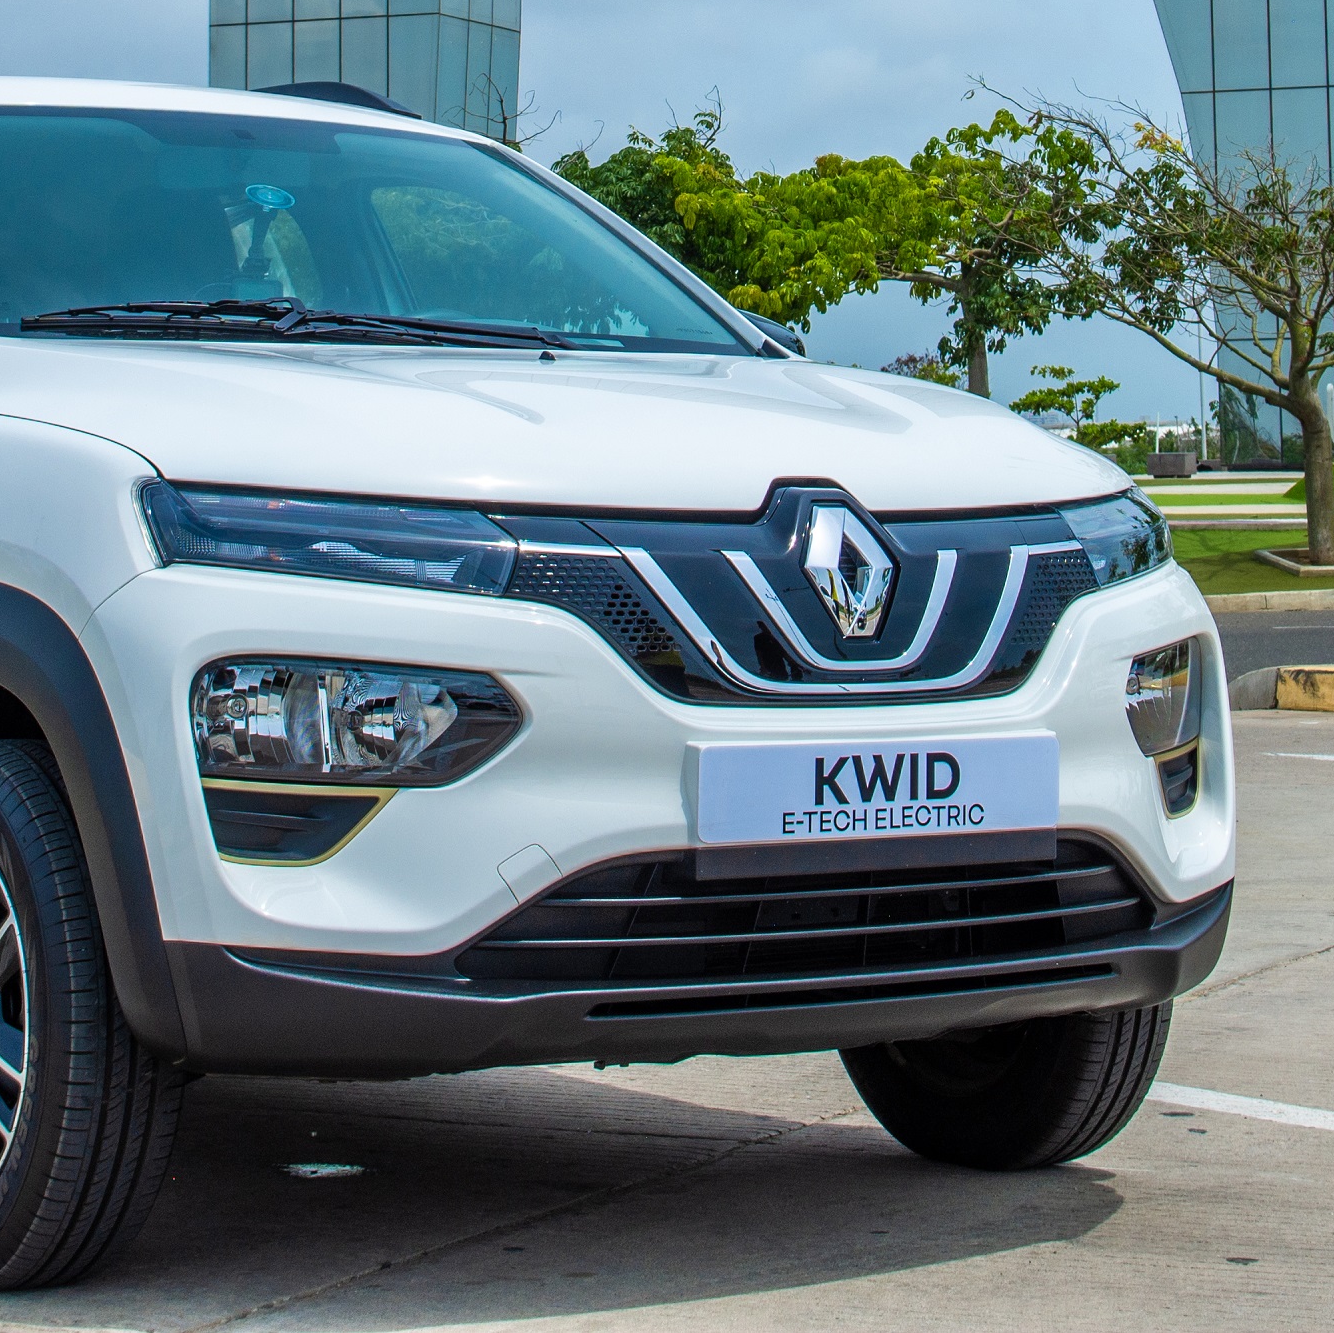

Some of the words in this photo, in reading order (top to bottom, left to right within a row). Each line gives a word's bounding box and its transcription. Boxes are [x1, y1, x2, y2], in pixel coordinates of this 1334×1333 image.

[815, 752, 960, 806] KWID
[782, 809, 867, 834] E-TECH
[875, 803, 985, 830] ELECTRIC
